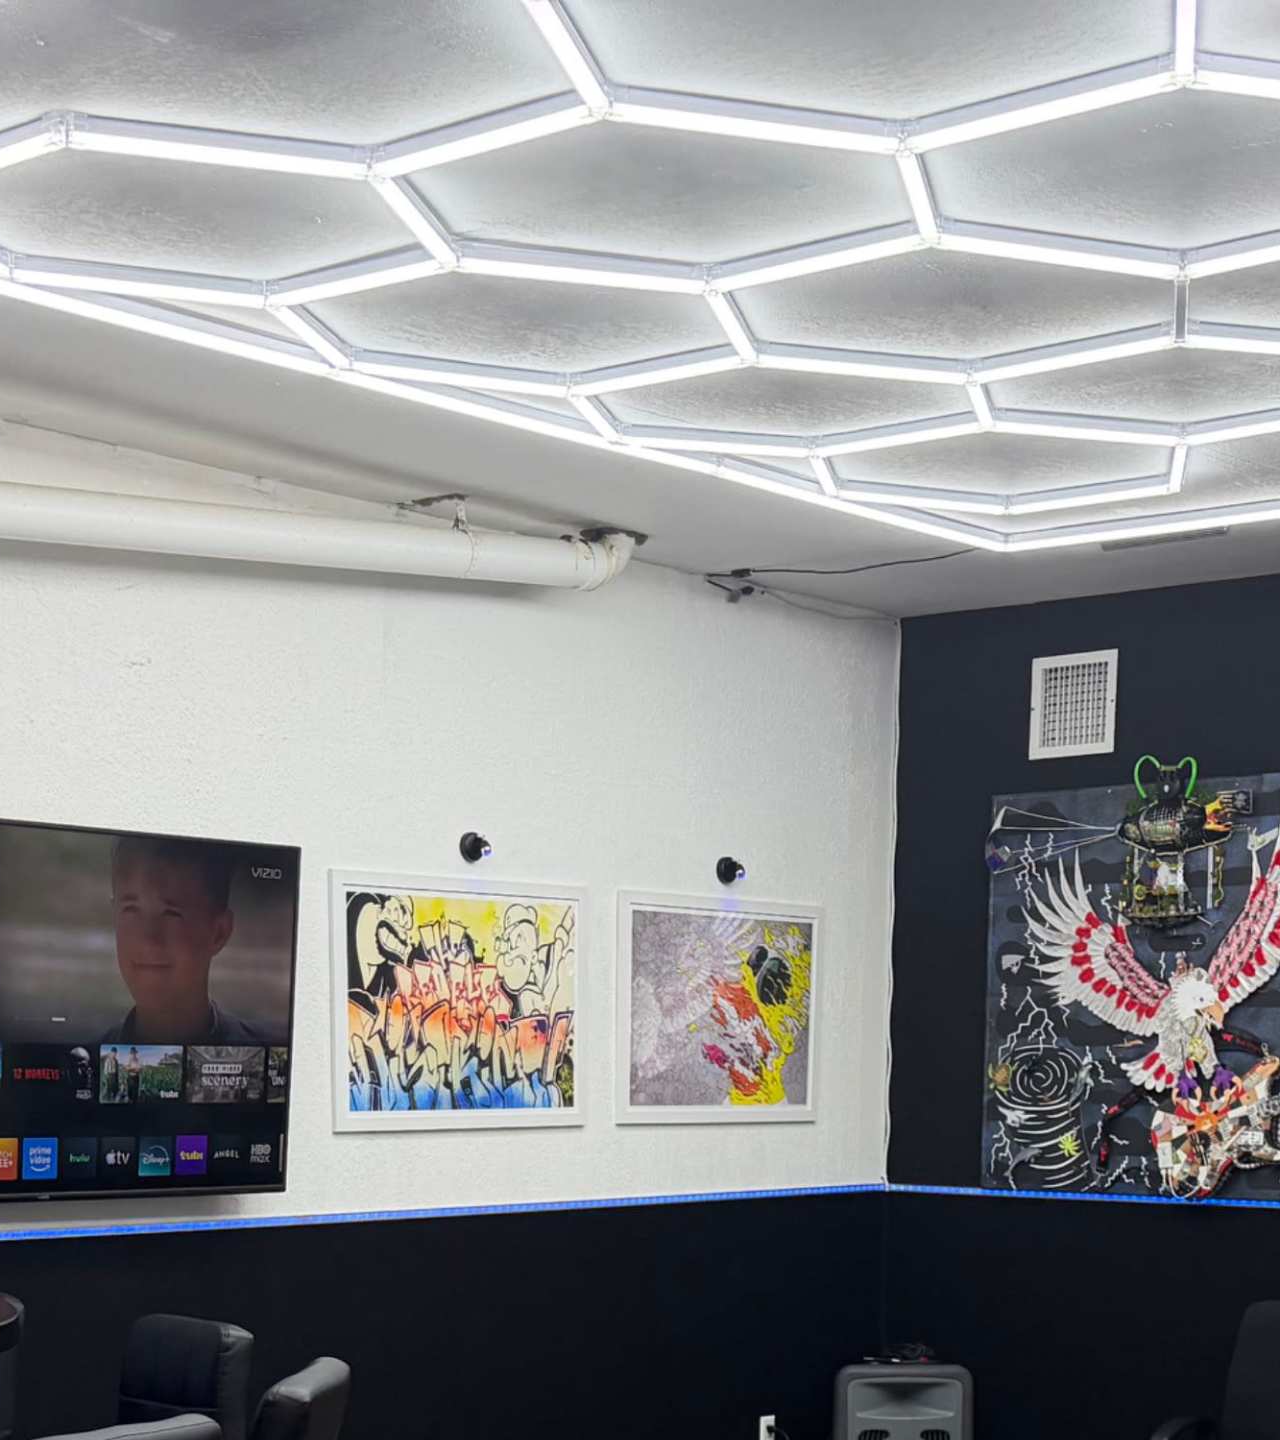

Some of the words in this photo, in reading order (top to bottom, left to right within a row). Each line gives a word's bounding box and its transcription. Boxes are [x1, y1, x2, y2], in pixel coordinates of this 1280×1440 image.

[251, 866, 282, 880] VIZIO
[201, 1075, 249, 1089] scenery
[29, 1147, 52, 1157] prime
[213, 1148, 240, 1159] ANGEL
[250, 1143, 272, 1154] HBO
[29, 1156, 51, 1165] video
[70, 1154, 90, 1163] hulu
[250, 1154, 271, 1163] max
